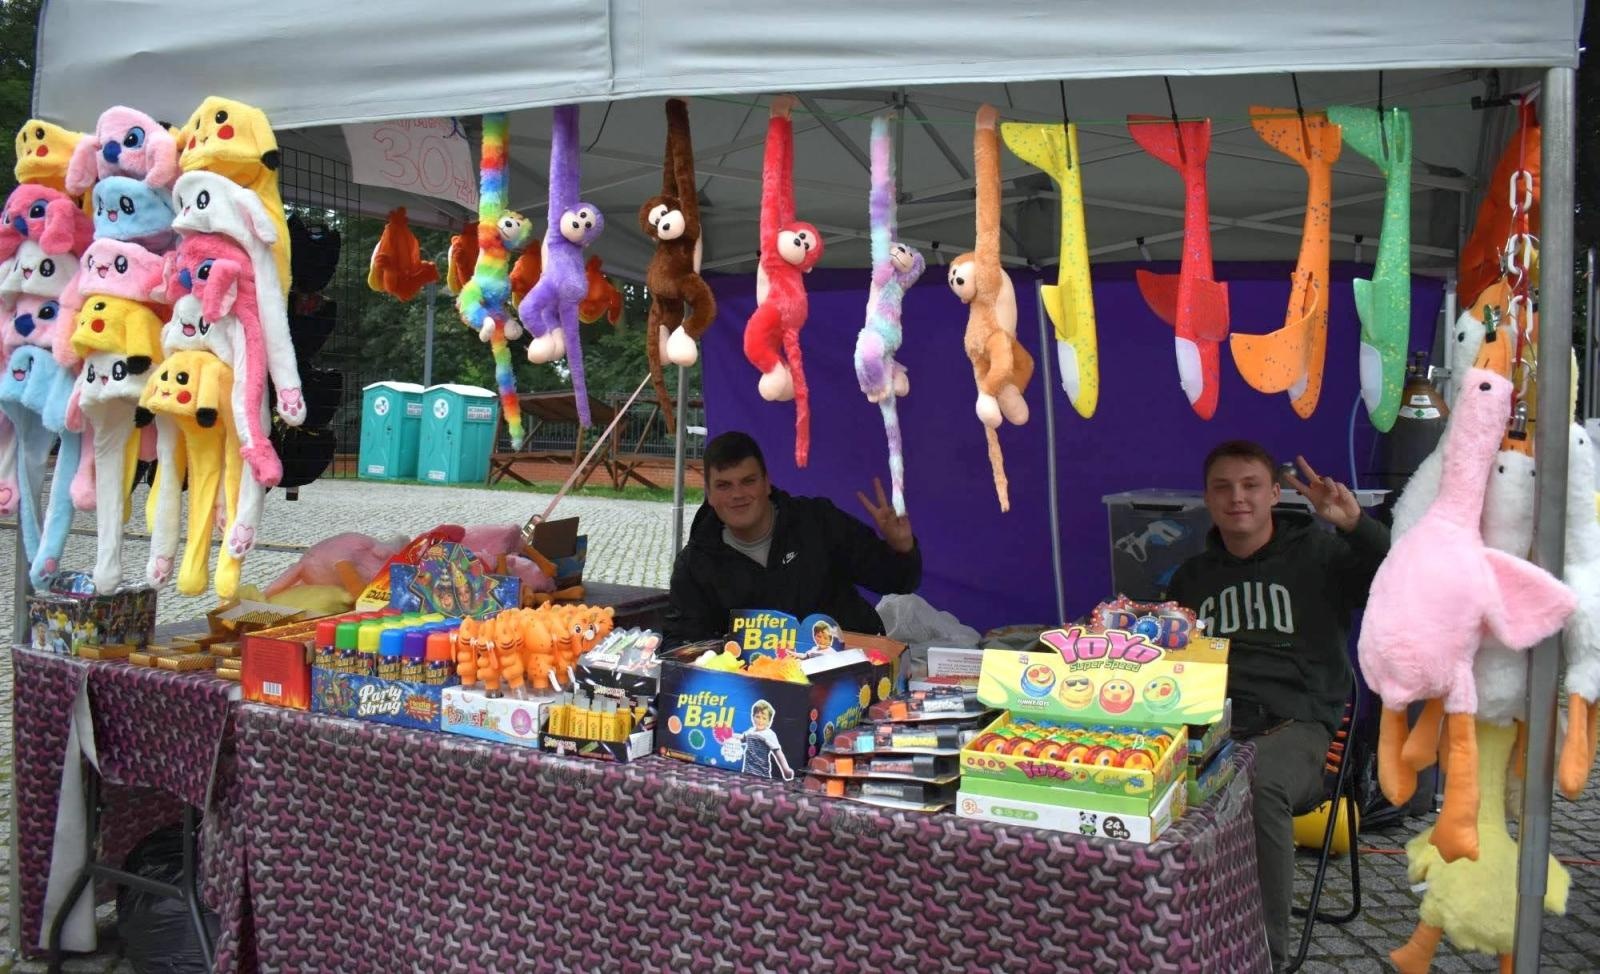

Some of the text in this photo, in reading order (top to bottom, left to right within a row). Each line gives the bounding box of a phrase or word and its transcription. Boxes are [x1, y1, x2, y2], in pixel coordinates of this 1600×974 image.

[374, 127, 454, 194] 30
[733, 614, 788, 633] puffer
[743, 628, 798, 650] Ball
[359, 685, 403, 703] Party
[677, 691, 728, 709] puffer
[683, 704, 736, 729] Ball
[1104, 821, 1121, 831] 24
[1113, 830, 1128, 840] pcs
